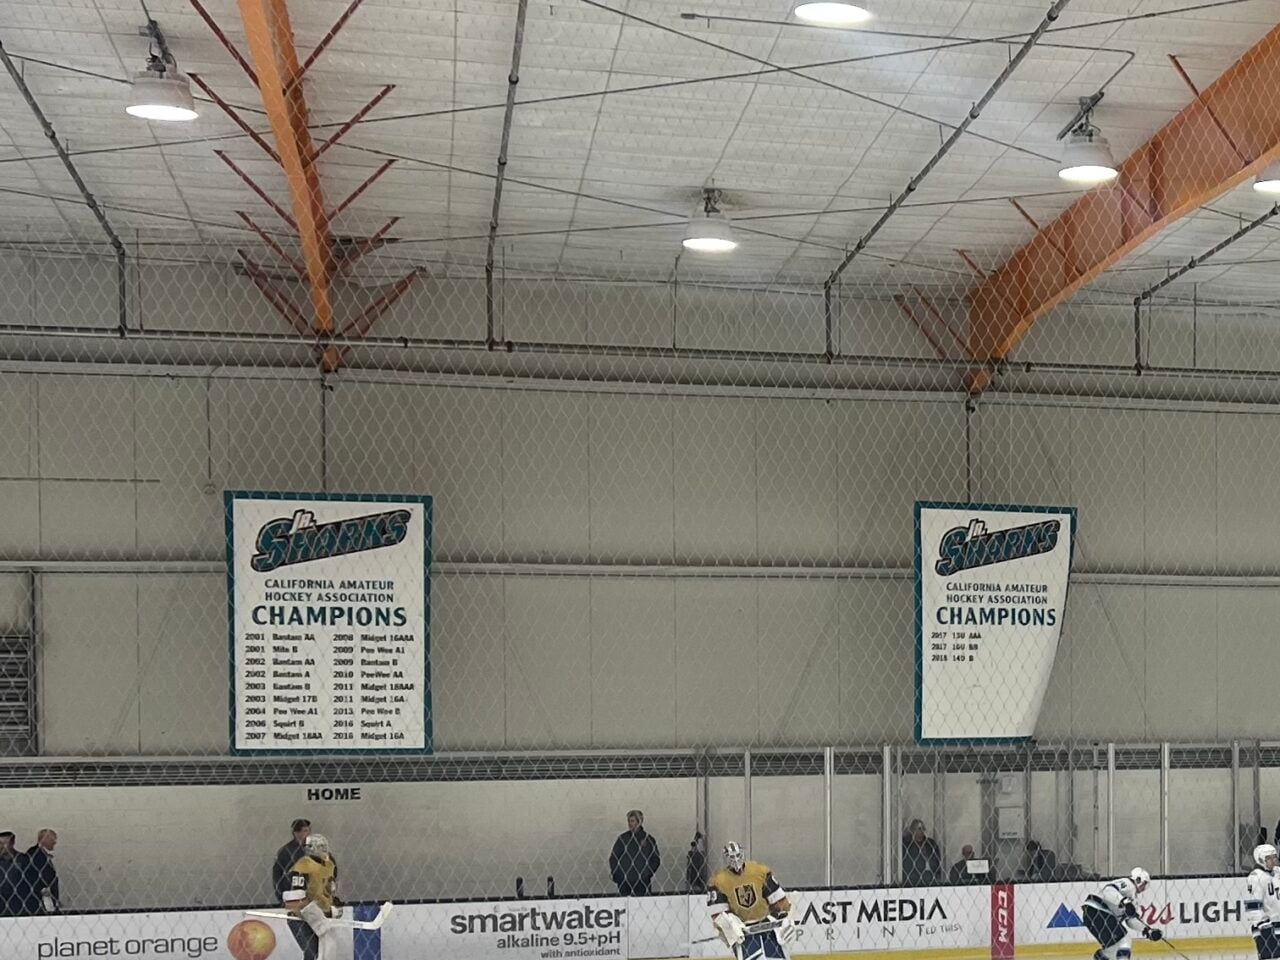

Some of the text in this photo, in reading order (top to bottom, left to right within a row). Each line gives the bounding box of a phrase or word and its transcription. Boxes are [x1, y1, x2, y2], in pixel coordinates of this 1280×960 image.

[264, 579, 394, 590] CALIFORNIA AMATEUR
[946, 582, 1048, 592] CALIFORNIA AMATEUR
[265, 592, 394, 602] HOCKEY ASSOCIATION
[946, 594, 1048, 604] HOCKEY ASSOCIATION
[252, 606, 407, 626] CHAMPIONS
[936, 606, 1056, 626] CHAMPIONS
[307, 788, 361, 800] HOME
[450, 906, 626, 934] smartwater
[795, 897, 947, 926] AST MEDIA
[998, 890, 1008, 943] CCM
[1180, 900, 1246, 923] LIGH
[125, 936, 218, 958] orange
[496, 931, 621, 949] alkaline 9.5+pH
[541, 948, 621, 959] with antioxidant
